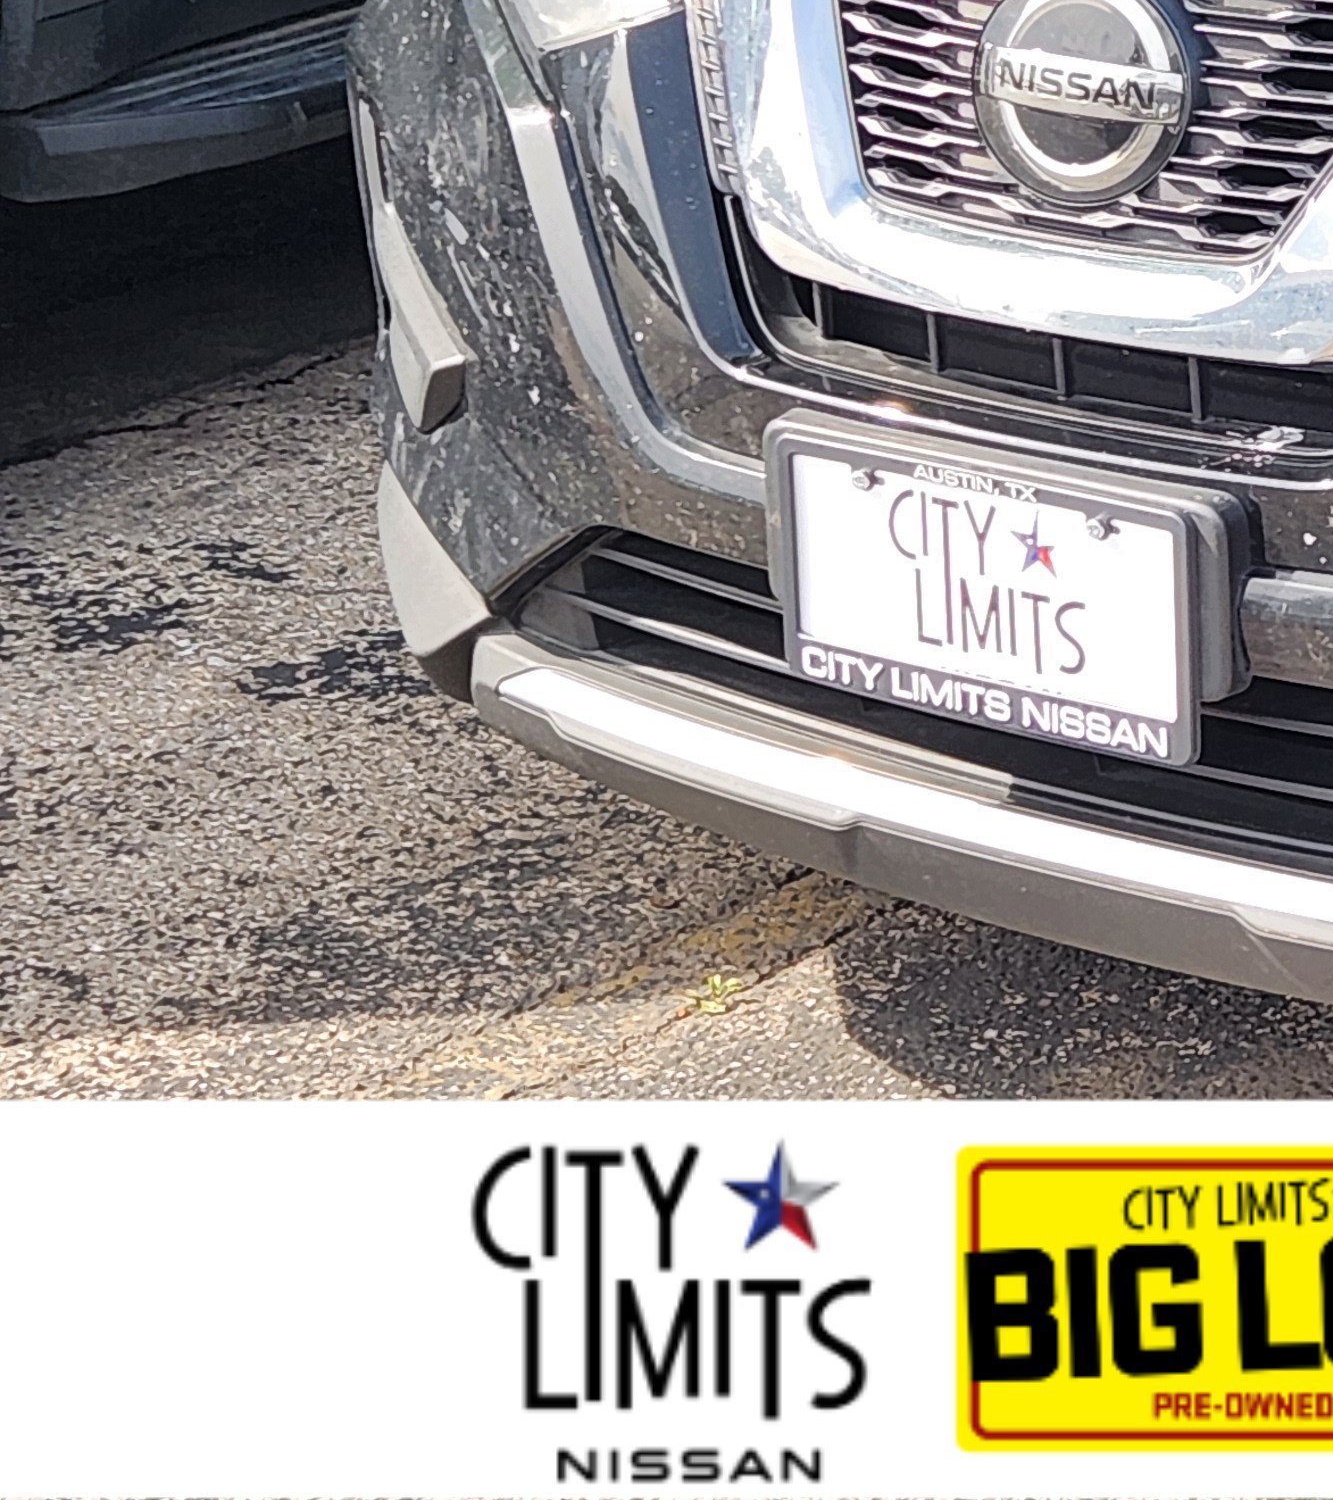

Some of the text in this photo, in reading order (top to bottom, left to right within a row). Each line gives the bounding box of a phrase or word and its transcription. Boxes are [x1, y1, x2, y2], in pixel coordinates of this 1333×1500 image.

[998, 57, 1157, 111] NISSAN
[912, 463, 1038, 503] AUSTIN, TX
[914, 568, 1087, 675] LIMITS
[801, 645, 1170, 759] CITY LIMITS NISSAN
